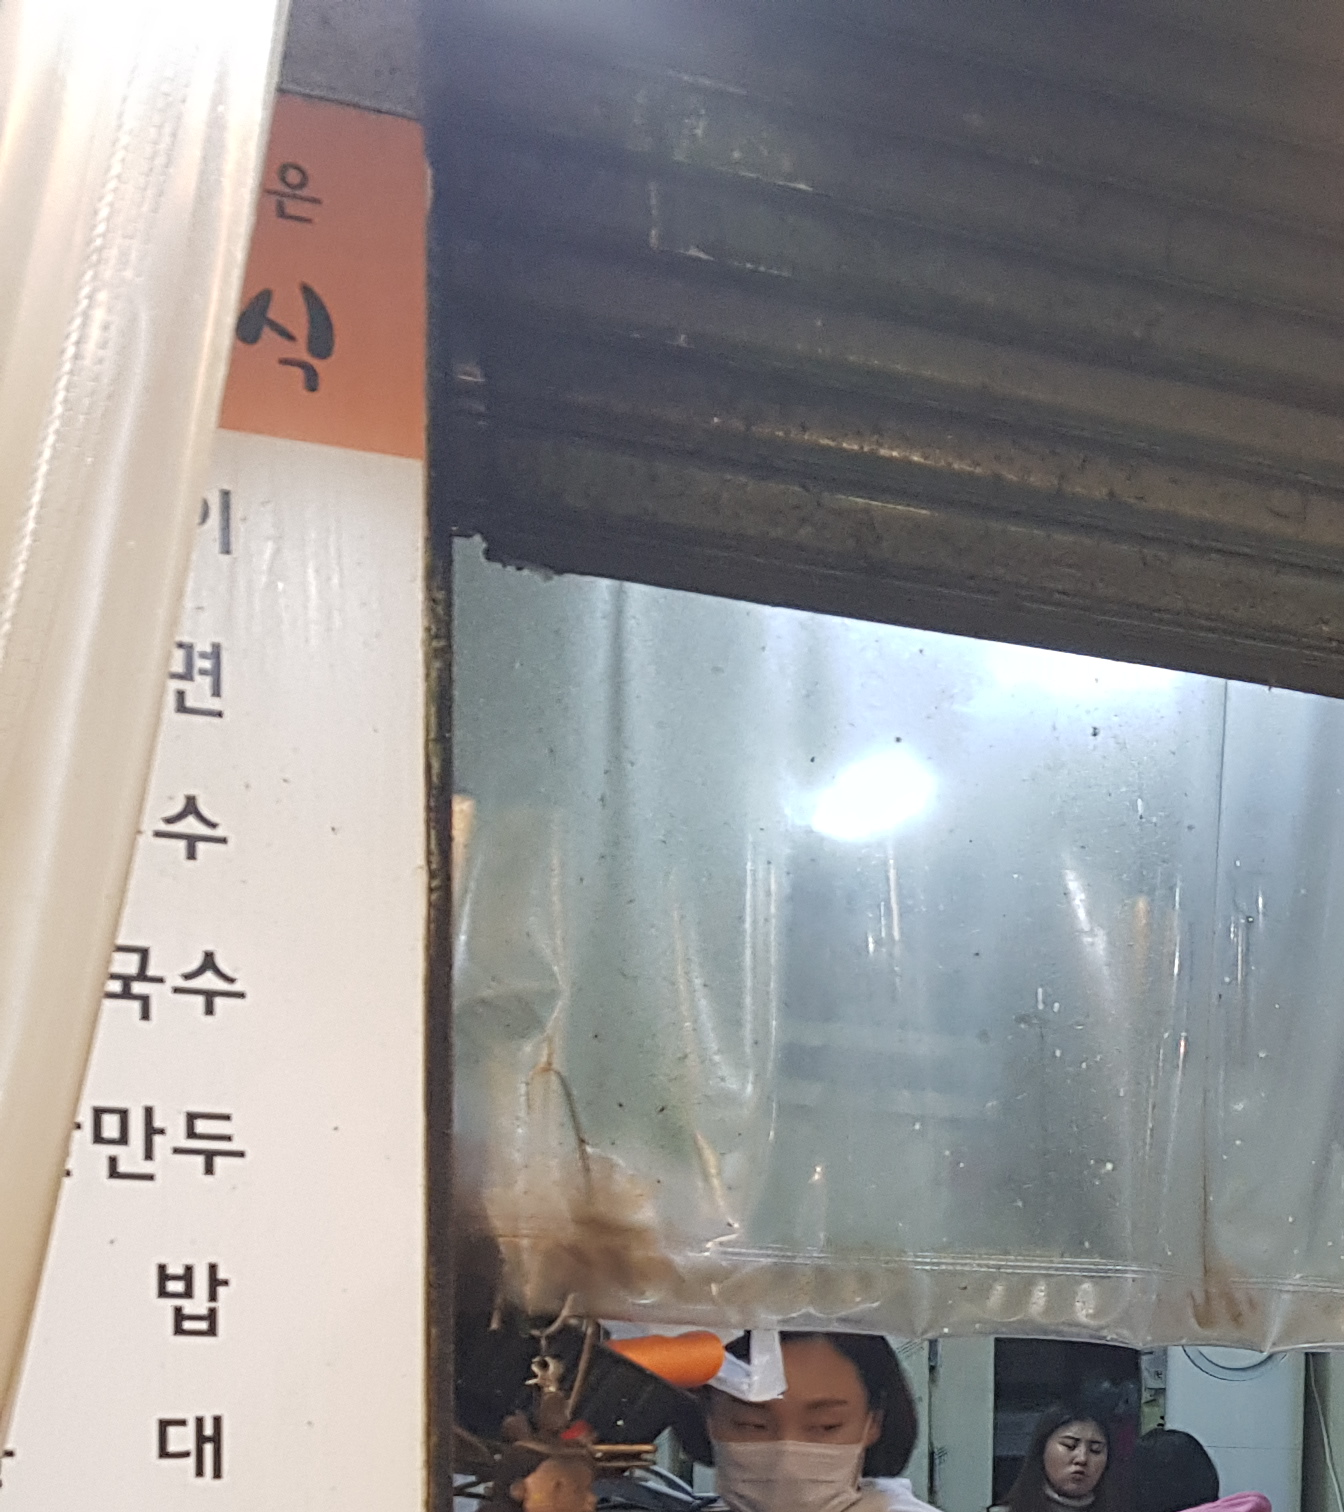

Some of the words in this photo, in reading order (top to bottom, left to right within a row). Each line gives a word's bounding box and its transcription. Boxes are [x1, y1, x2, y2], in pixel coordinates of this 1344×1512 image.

[263, 160, 323, 224] 은
[235, 281, 336, 394] 식
[168, 640, 225, 719] 면
[152, 794, 229, 861] 수
[105, 943, 247, 1020] 국수
[64, 1104, 247, 1182] 만두
[155, 1261, 232, 1338] 밥
[156, 1414, 225, 1480] 대
